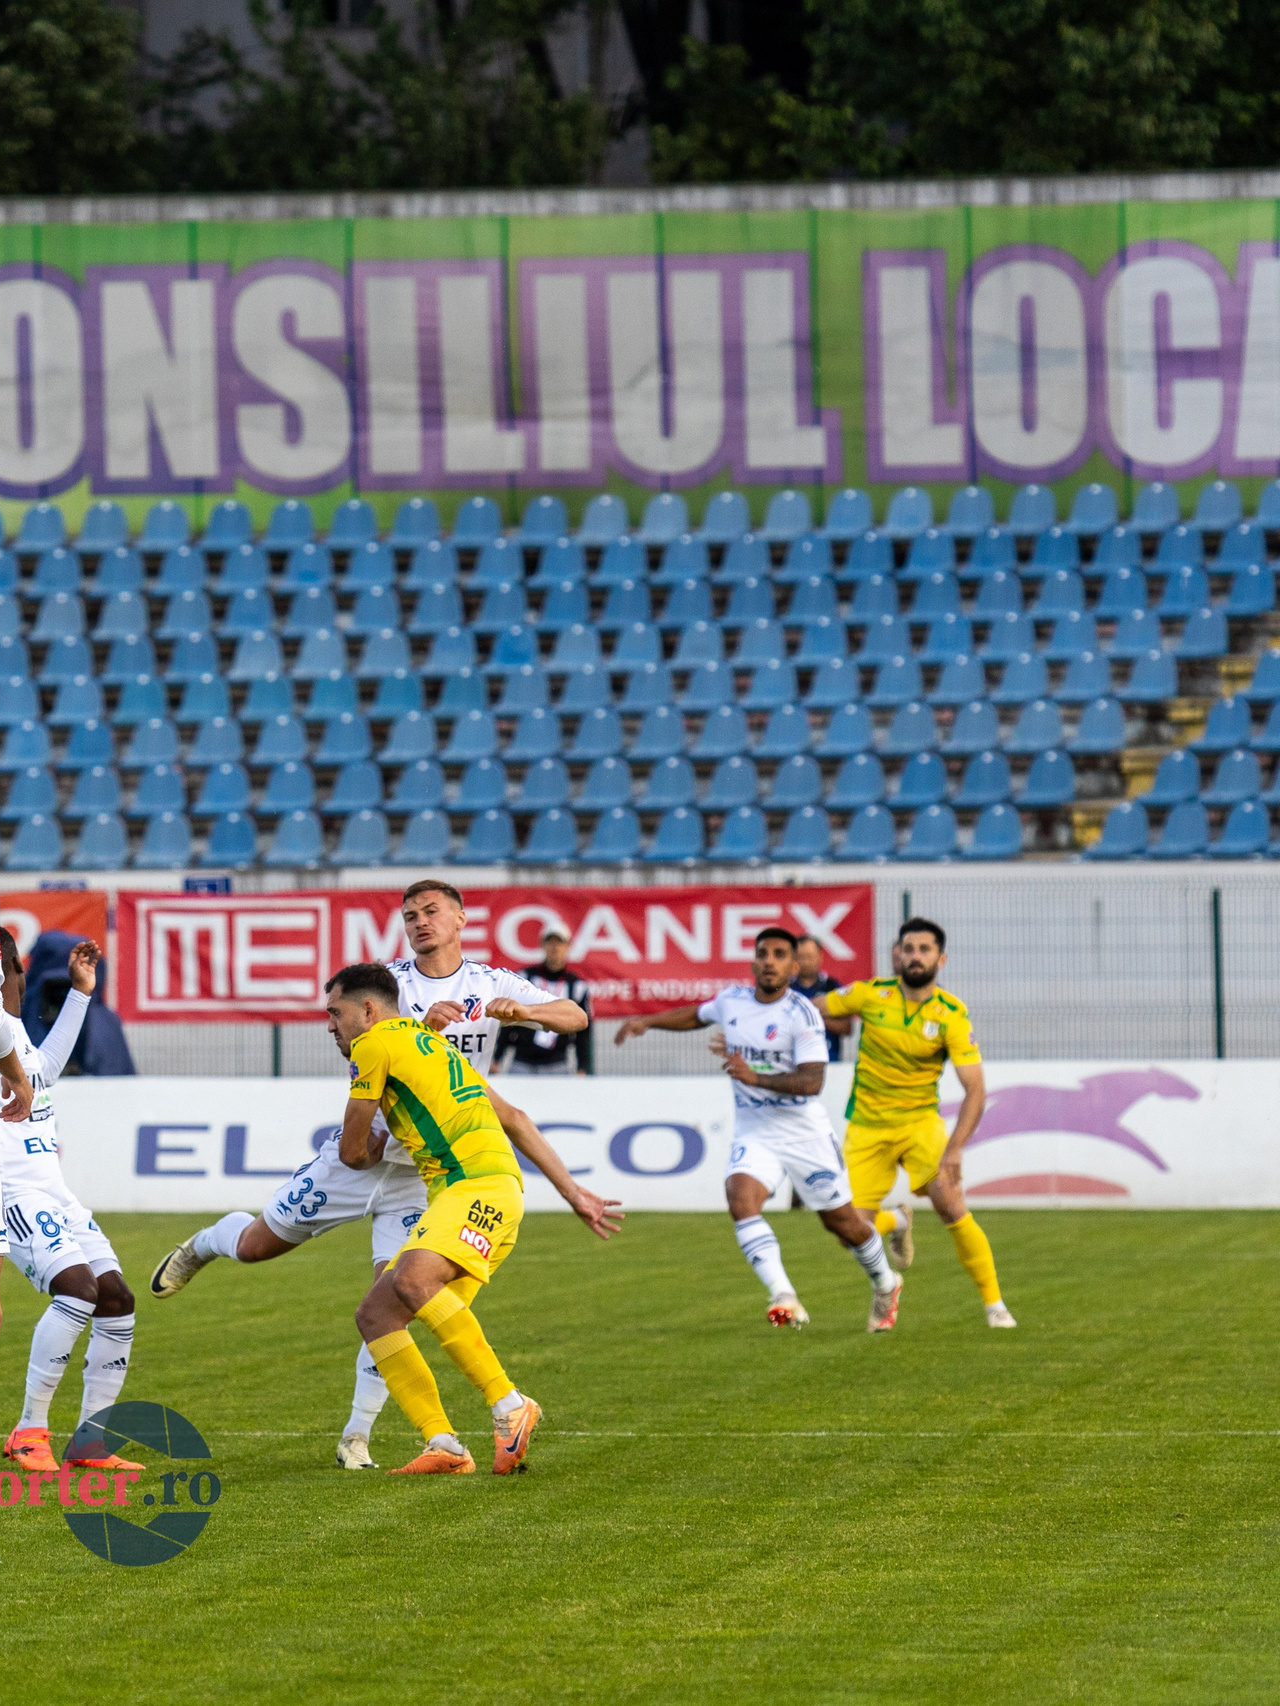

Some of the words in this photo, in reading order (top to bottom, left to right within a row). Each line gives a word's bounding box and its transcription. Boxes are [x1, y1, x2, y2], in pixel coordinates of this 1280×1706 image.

[288, 1177, 327, 1218] 33
[35, 1210, 60, 1238] 8
[467, 1211, 495, 1232] DIN
[470, 1199, 503, 1225] APA
[460, 1226, 492, 1258] NOY
